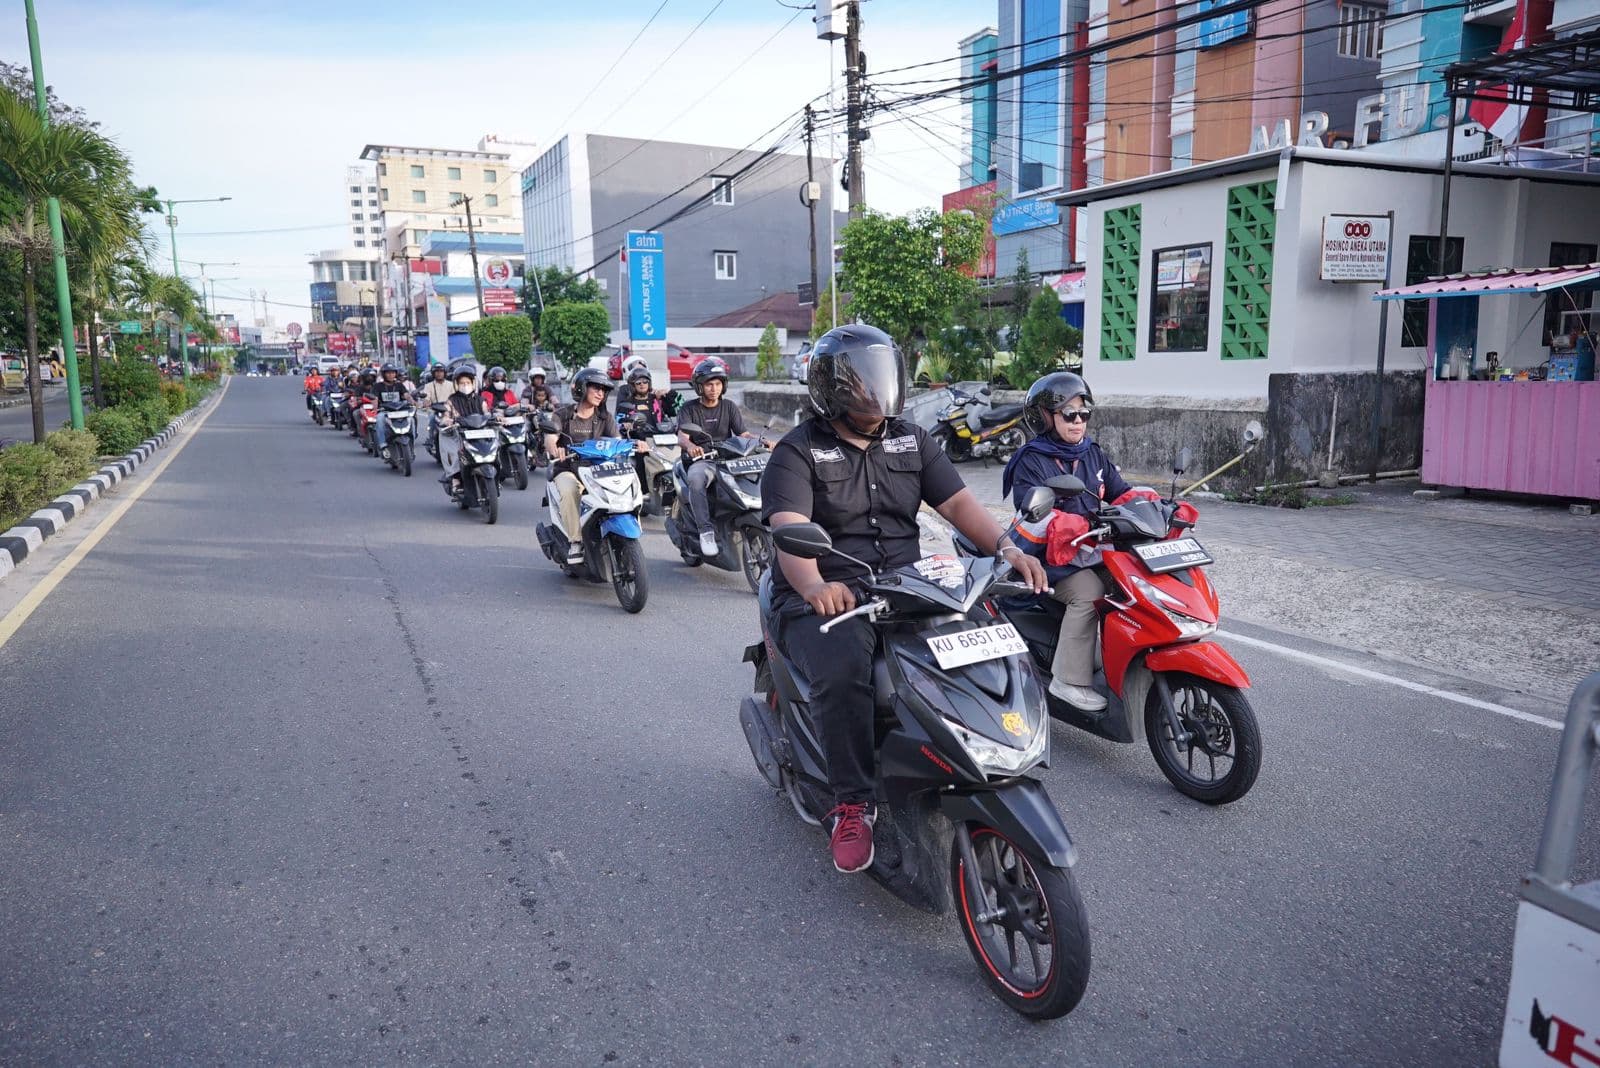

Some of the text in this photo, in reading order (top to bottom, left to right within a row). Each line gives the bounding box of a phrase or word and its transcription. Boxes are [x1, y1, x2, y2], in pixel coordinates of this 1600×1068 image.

[1013, 203, 1034, 217] TRUST
[1346, 224, 1370, 236] HAU
[636, 235, 656, 247] atm
[1350, 240, 1367, 251] ANEKA
[1369, 241, 1386, 251] UTAMA
[642, 255, 650, 281] BANK
[642, 282, 650, 313] TRUST
[1118, 613, 1142, 630] HONDA
[932, 626, 1016, 653] KU 6651 GU
[921, 744, 953, 774] HONDA
